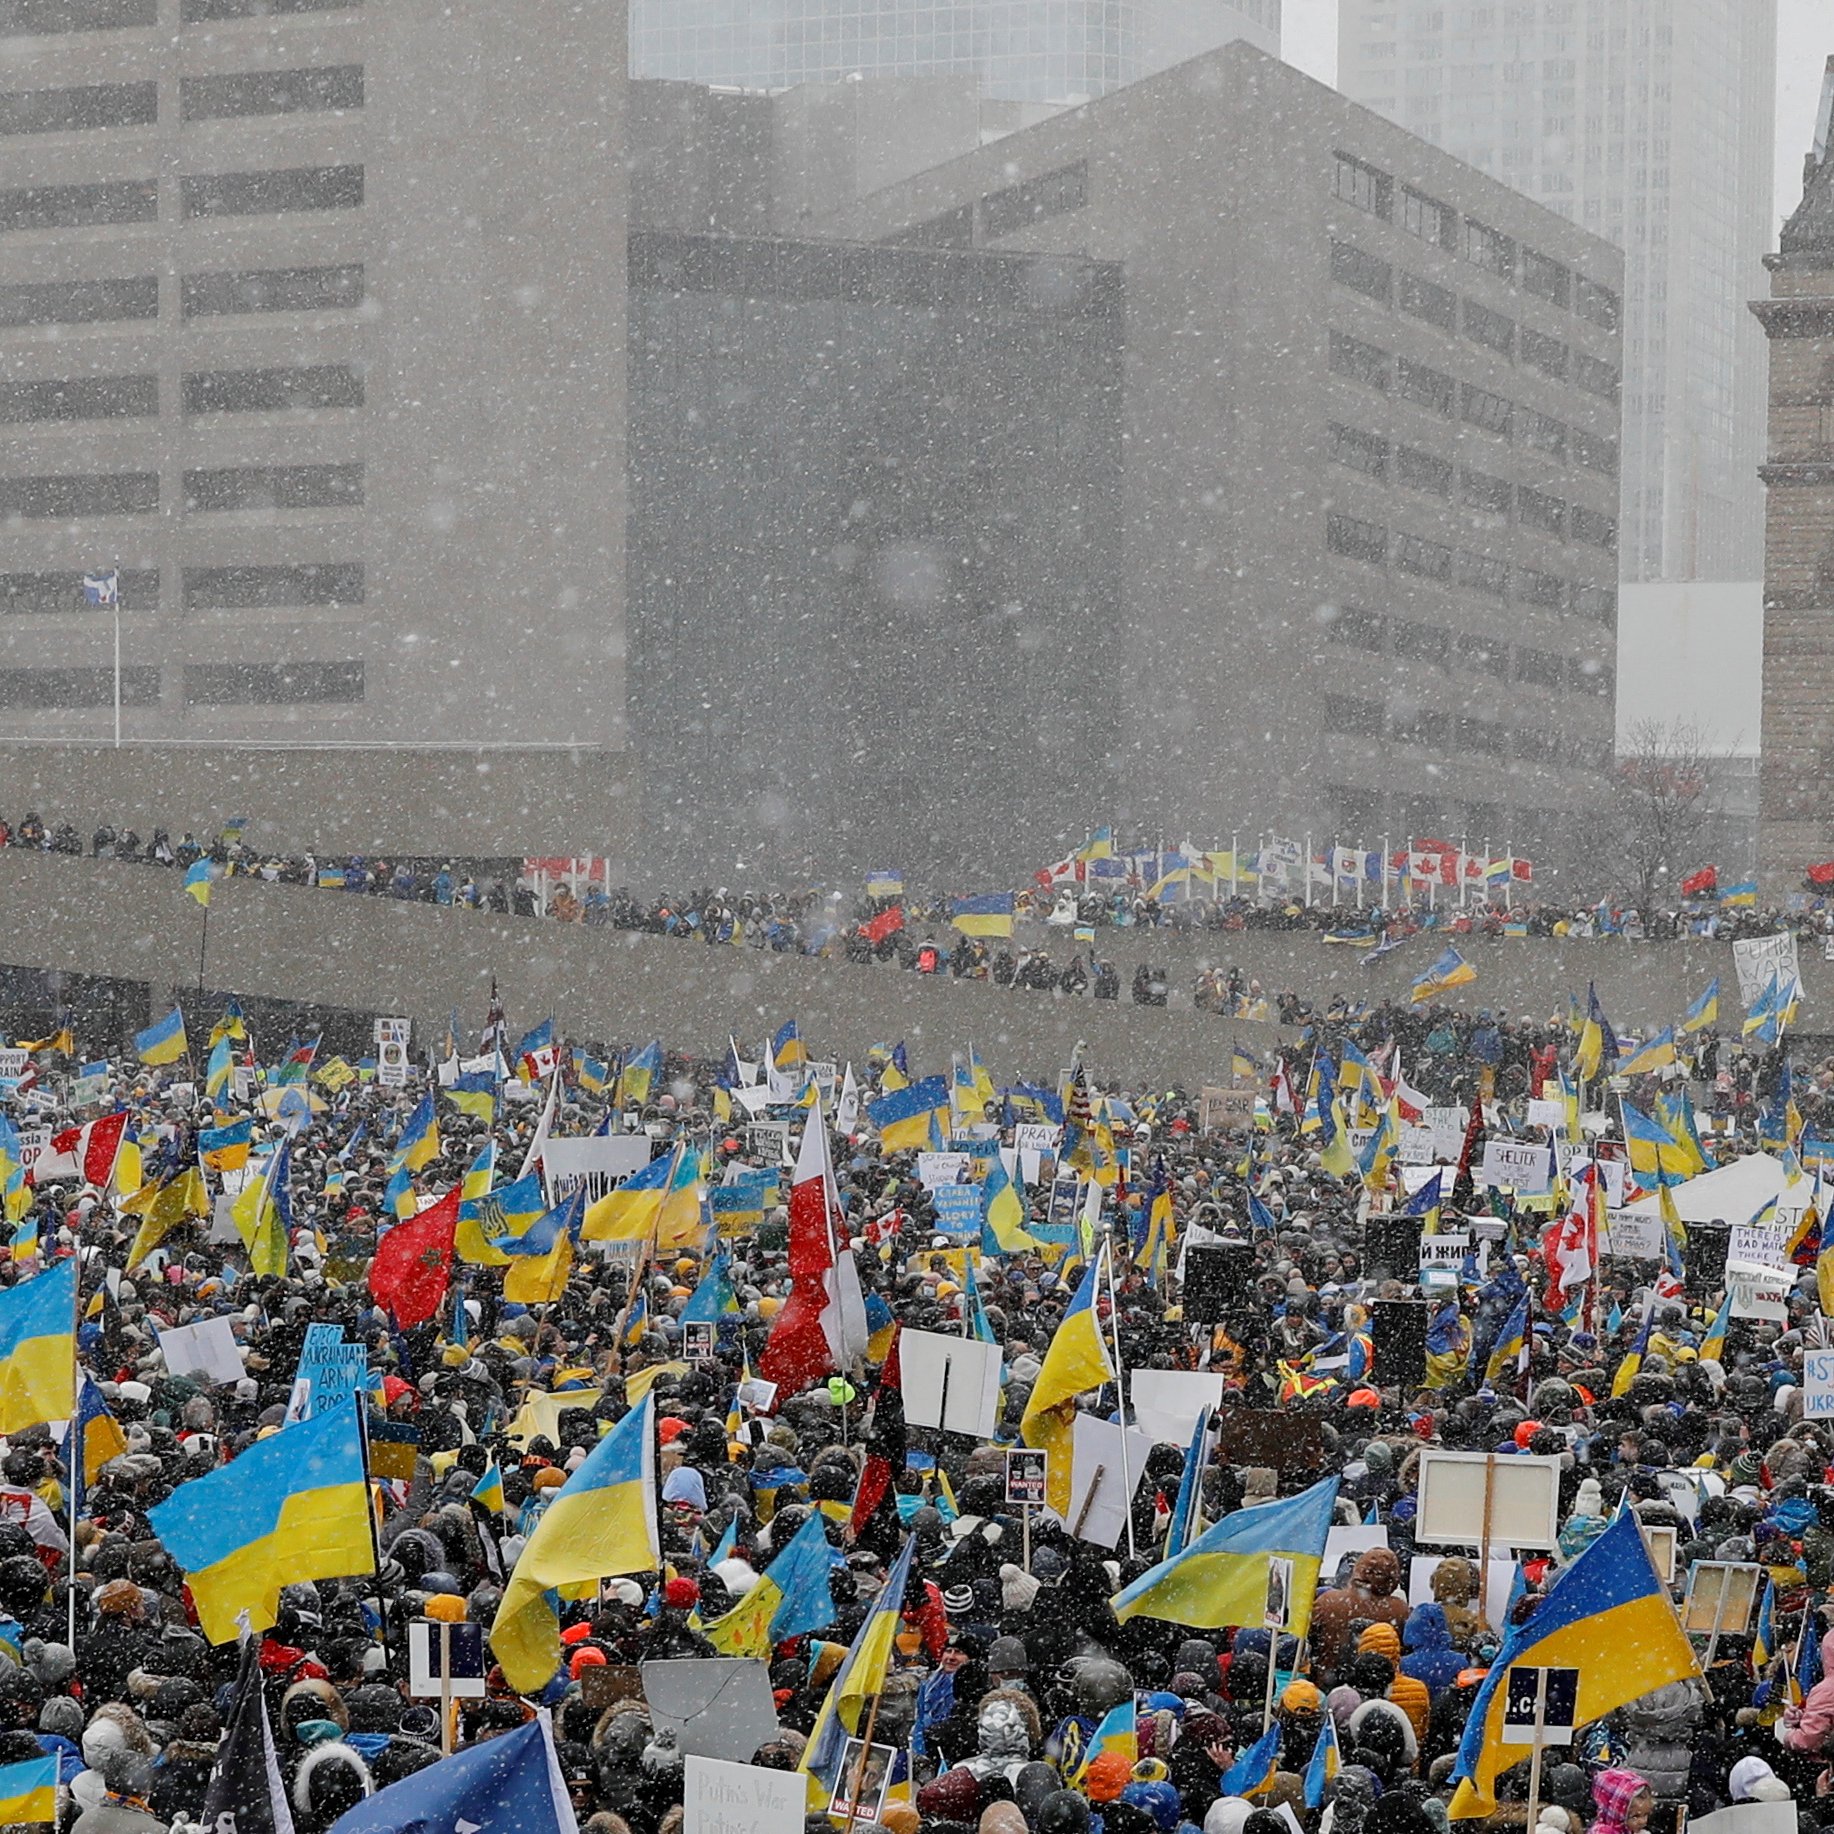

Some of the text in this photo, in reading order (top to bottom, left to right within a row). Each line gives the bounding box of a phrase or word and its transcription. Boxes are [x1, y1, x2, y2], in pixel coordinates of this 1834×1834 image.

[1734, 938, 1793, 960] PUTIN
[1742, 956, 1794, 980] WAR
[1426, 1110, 1456, 1118] STOP
[19, 1133, 40, 1145] ssia
[1022, 1127, 1056, 1140] PRAY
[20, 1149, 41, 1165] OP
[1496, 1149, 1537, 1166] SHELTER
[588, 1169, 638, 1204] Ukrai
[939, 1211, 975, 1221] GLORY
[1775, 1207, 1824, 1225] STP
[1736, 1228, 1782, 1243] THERE IS
[1737, 1239, 1759, 1249] BAD
[1738, 1251, 1768, 1260] THERE
[309, 1326, 344, 1346] EJECT
[303, 1345, 366, 1367] UKRAINIAN
[318, 1367, 361, 1388] ARMY
[317, 1392, 353, 1411] ROO
[1010, 1480, 1044, 1490] WANTED
[697, 1772, 788, 1812] Putin's War
[834, 1798, 875, 1819] WATED
